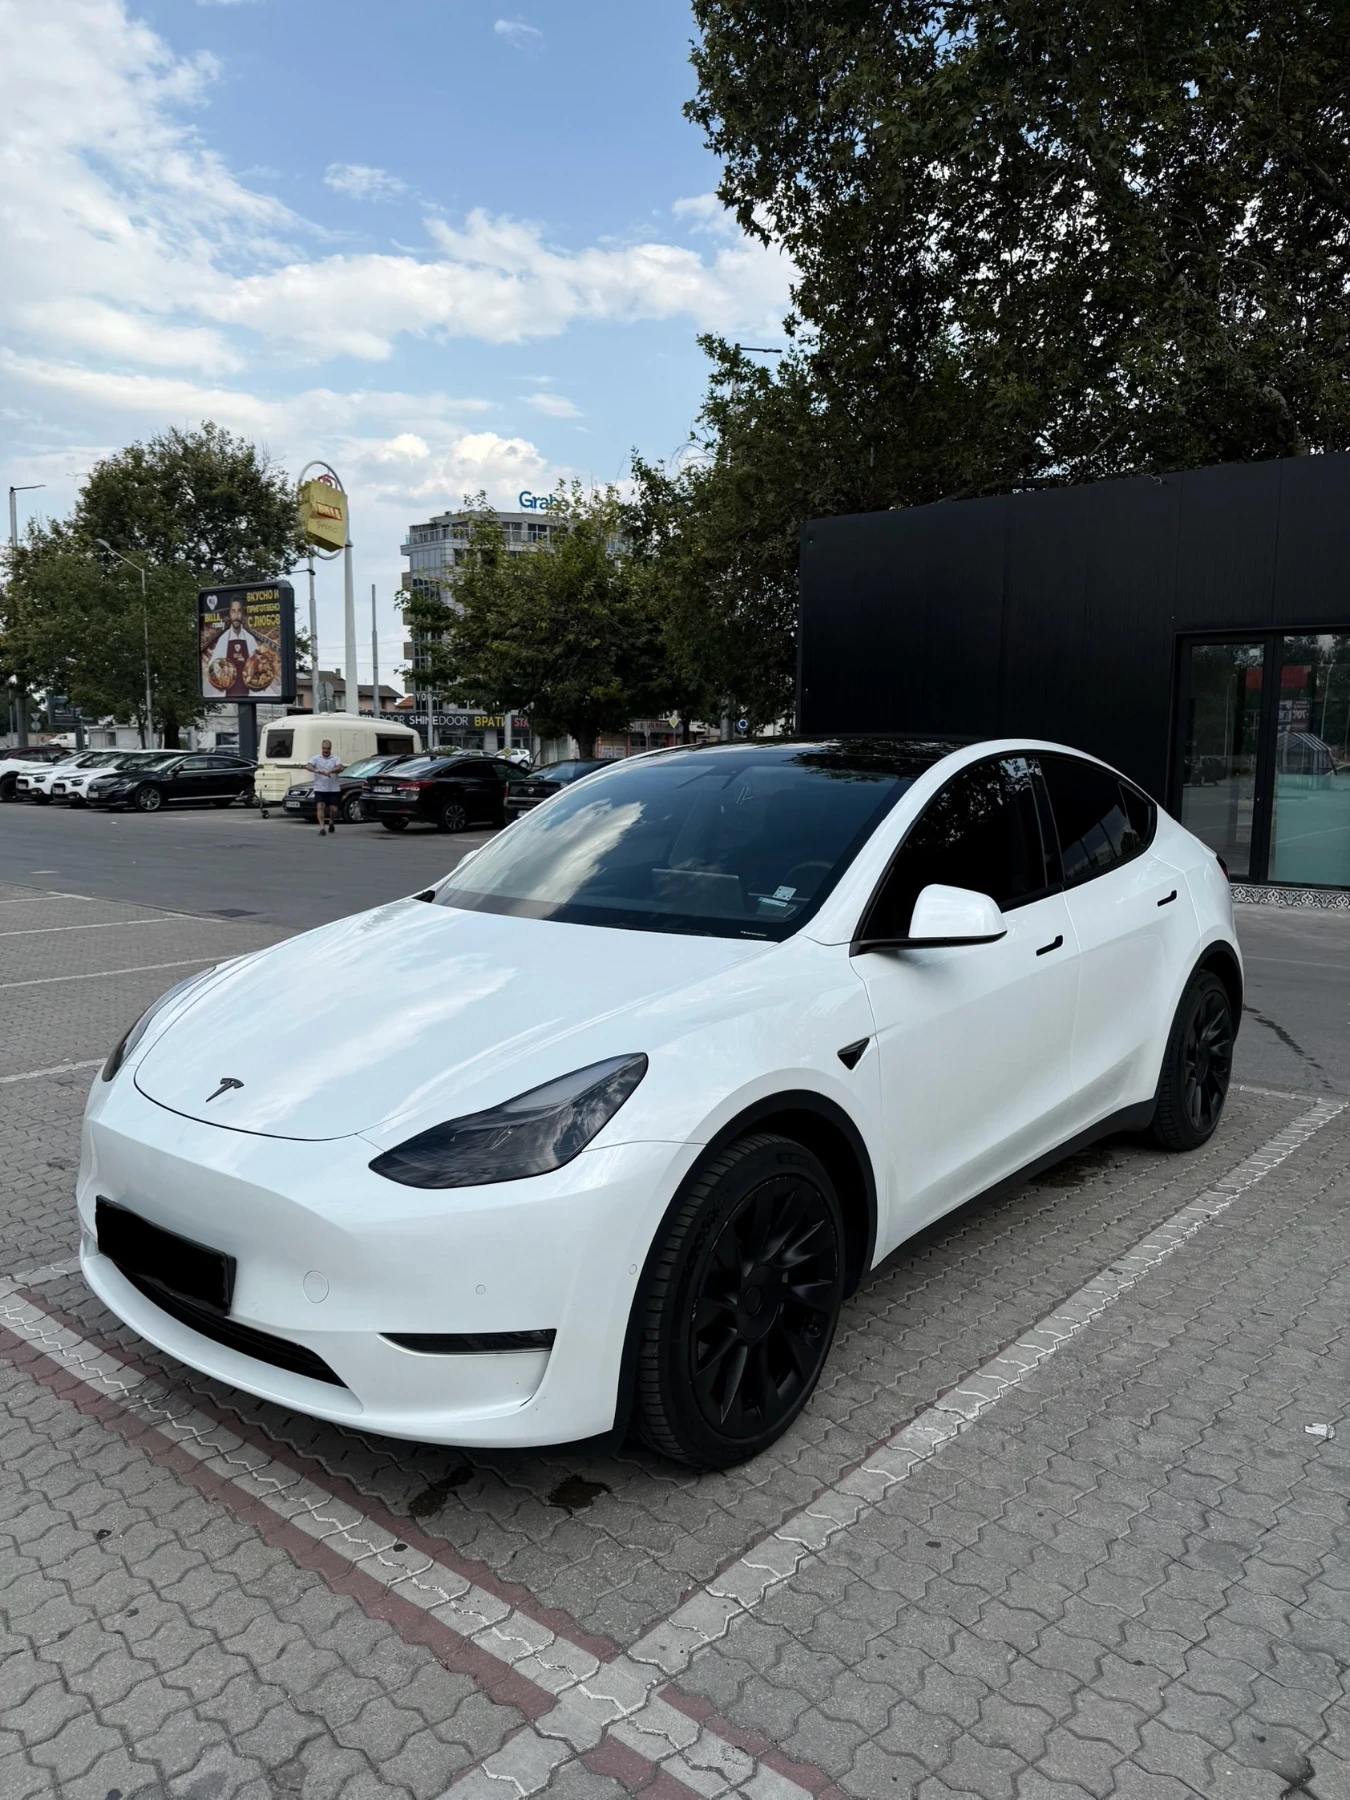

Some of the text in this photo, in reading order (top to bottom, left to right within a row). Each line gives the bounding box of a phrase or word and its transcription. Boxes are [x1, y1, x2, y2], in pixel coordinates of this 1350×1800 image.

[246, 590, 273, 602] ВКУСНО
[204, 612, 221, 623] BILLA
[247, 616, 253, 627] С
